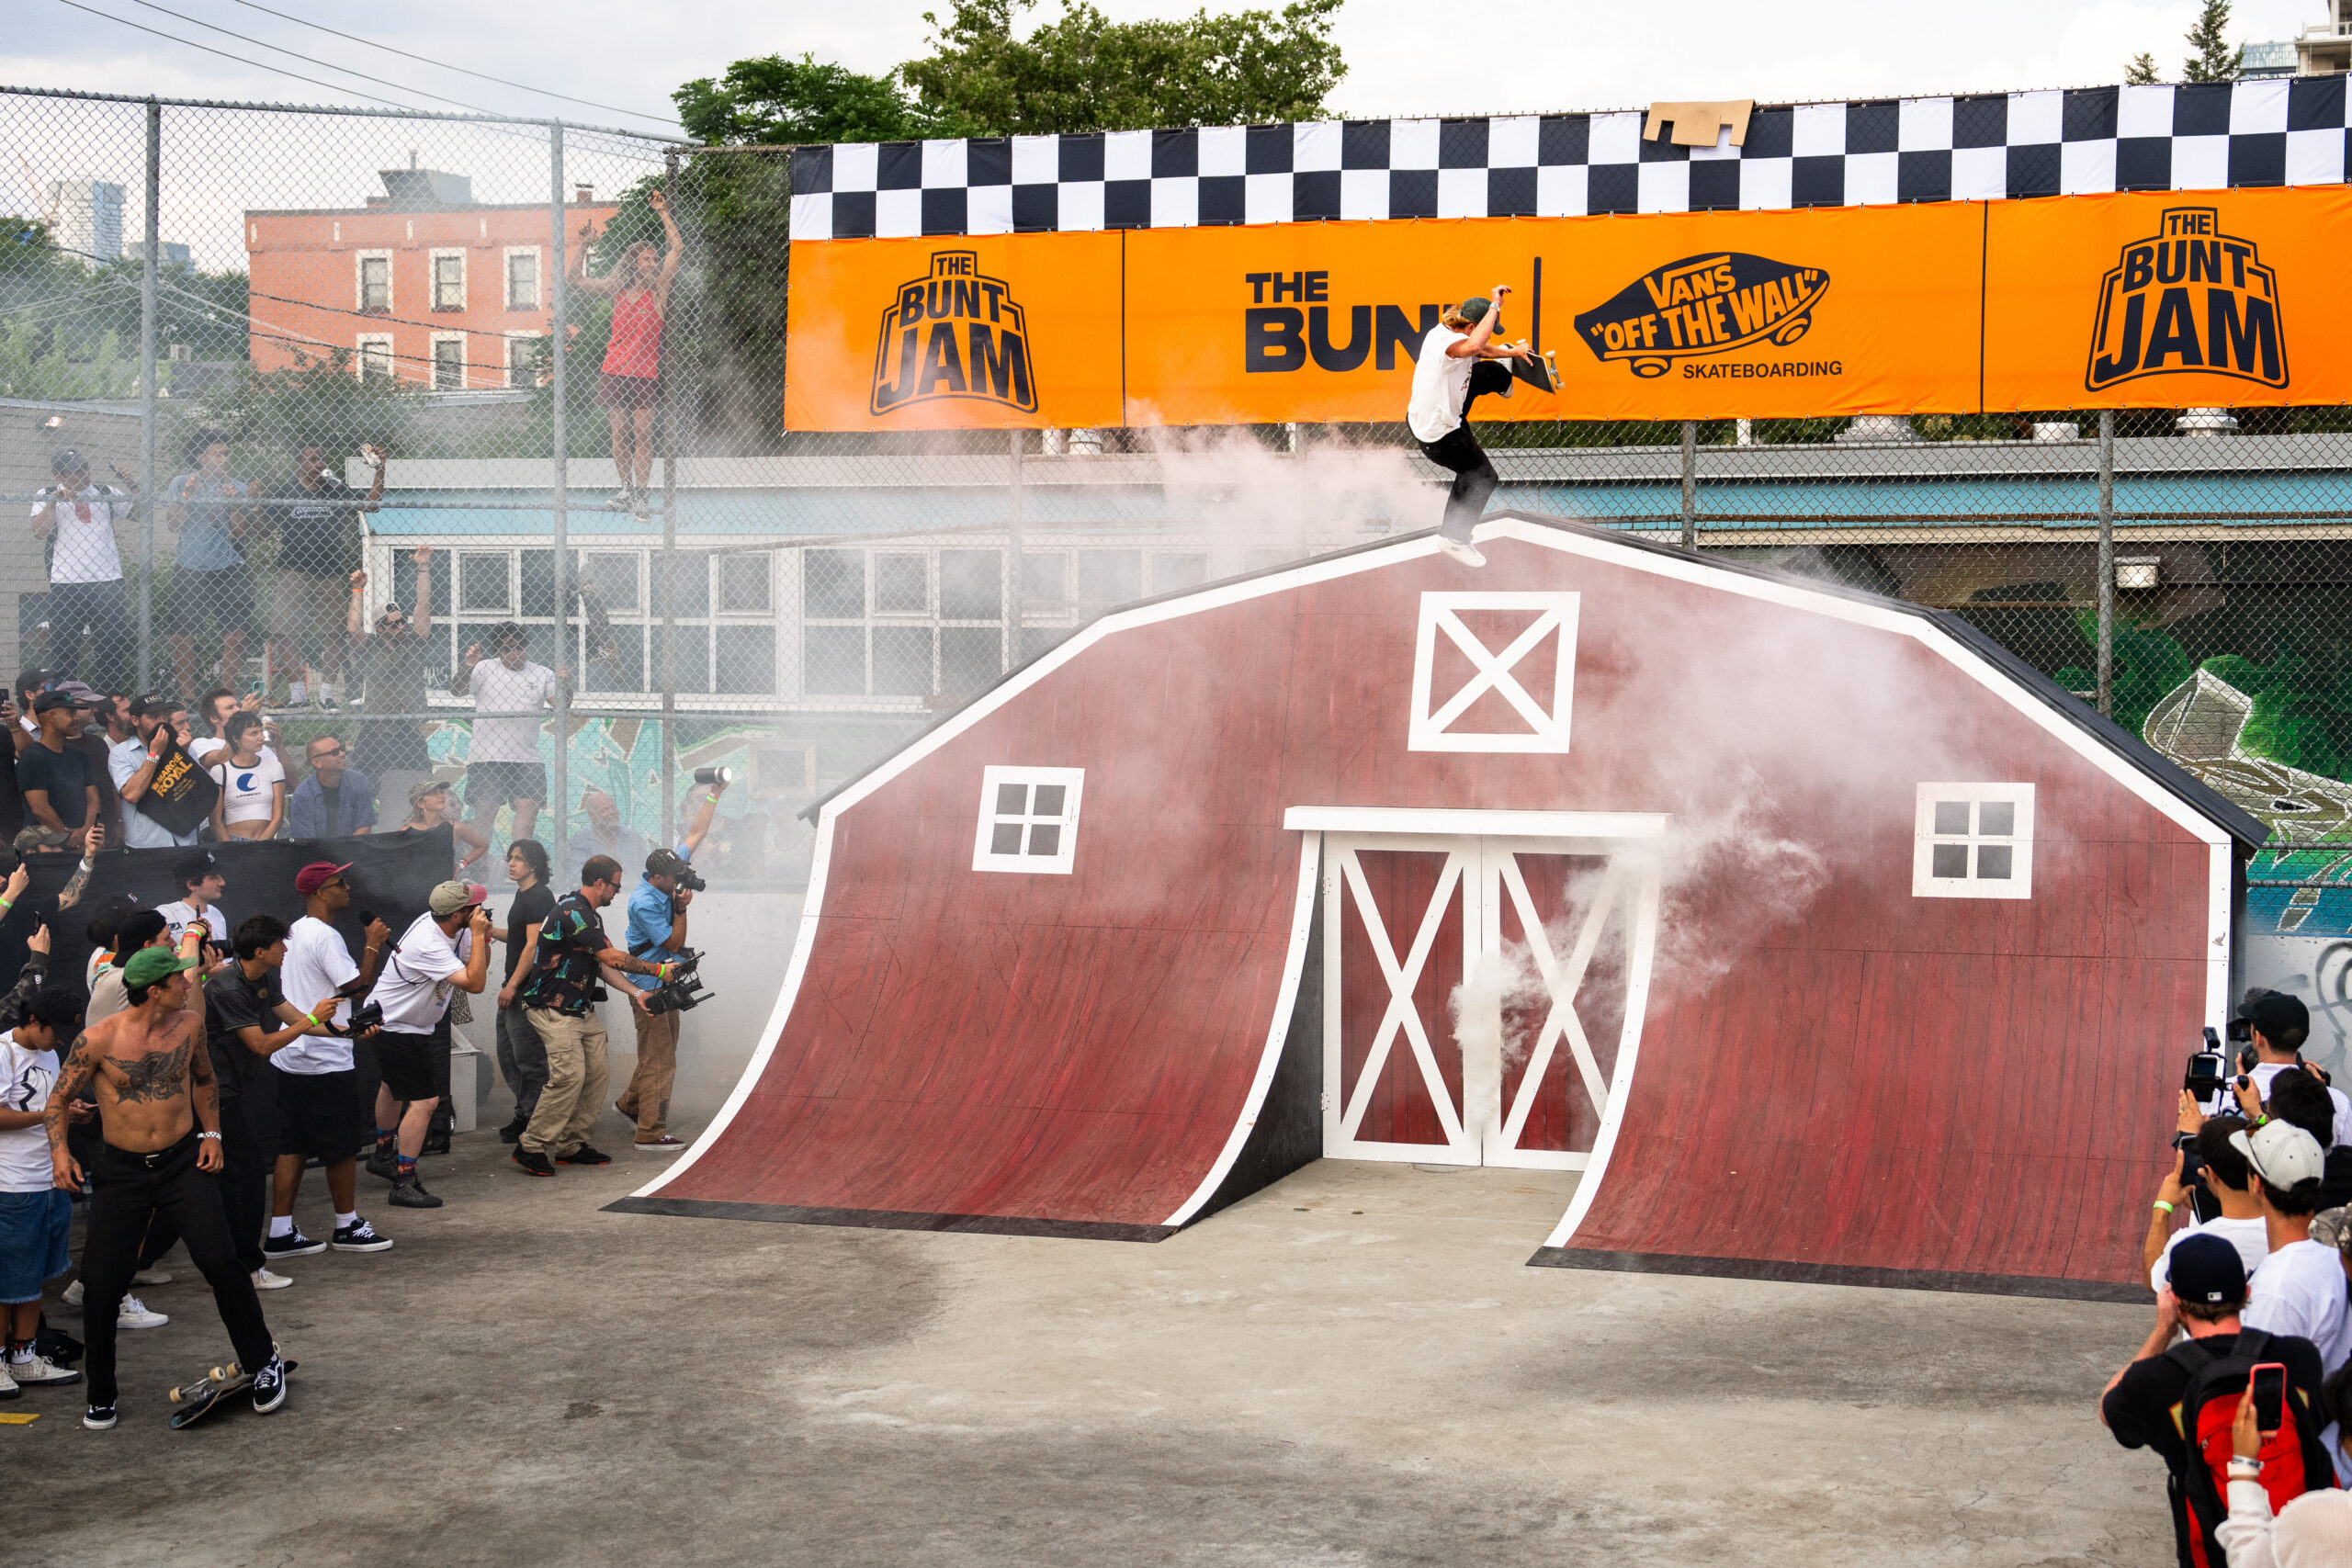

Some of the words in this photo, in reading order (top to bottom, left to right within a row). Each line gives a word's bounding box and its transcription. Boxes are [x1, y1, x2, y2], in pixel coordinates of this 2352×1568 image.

[2167, 213, 2211, 236] THE
[935, 256, 972, 276] THE
[1245, 270, 1329, 303] THE
[1643, 254, 1736, 310] VANS
[2121, 239, 2252, 294] BUNT
[899, 279, 1004, 329] BUNT
[1660, 295, 1731, 347] THE
[1245, 304, 1500, 373] BUN
[2093, 287, 2281, 384] JAM
[876, 321, 1032, 409] JAM
[1682, 360, 1843, 379] SKATEBOARDING
[155, 761, 193, 798] ROYAL
